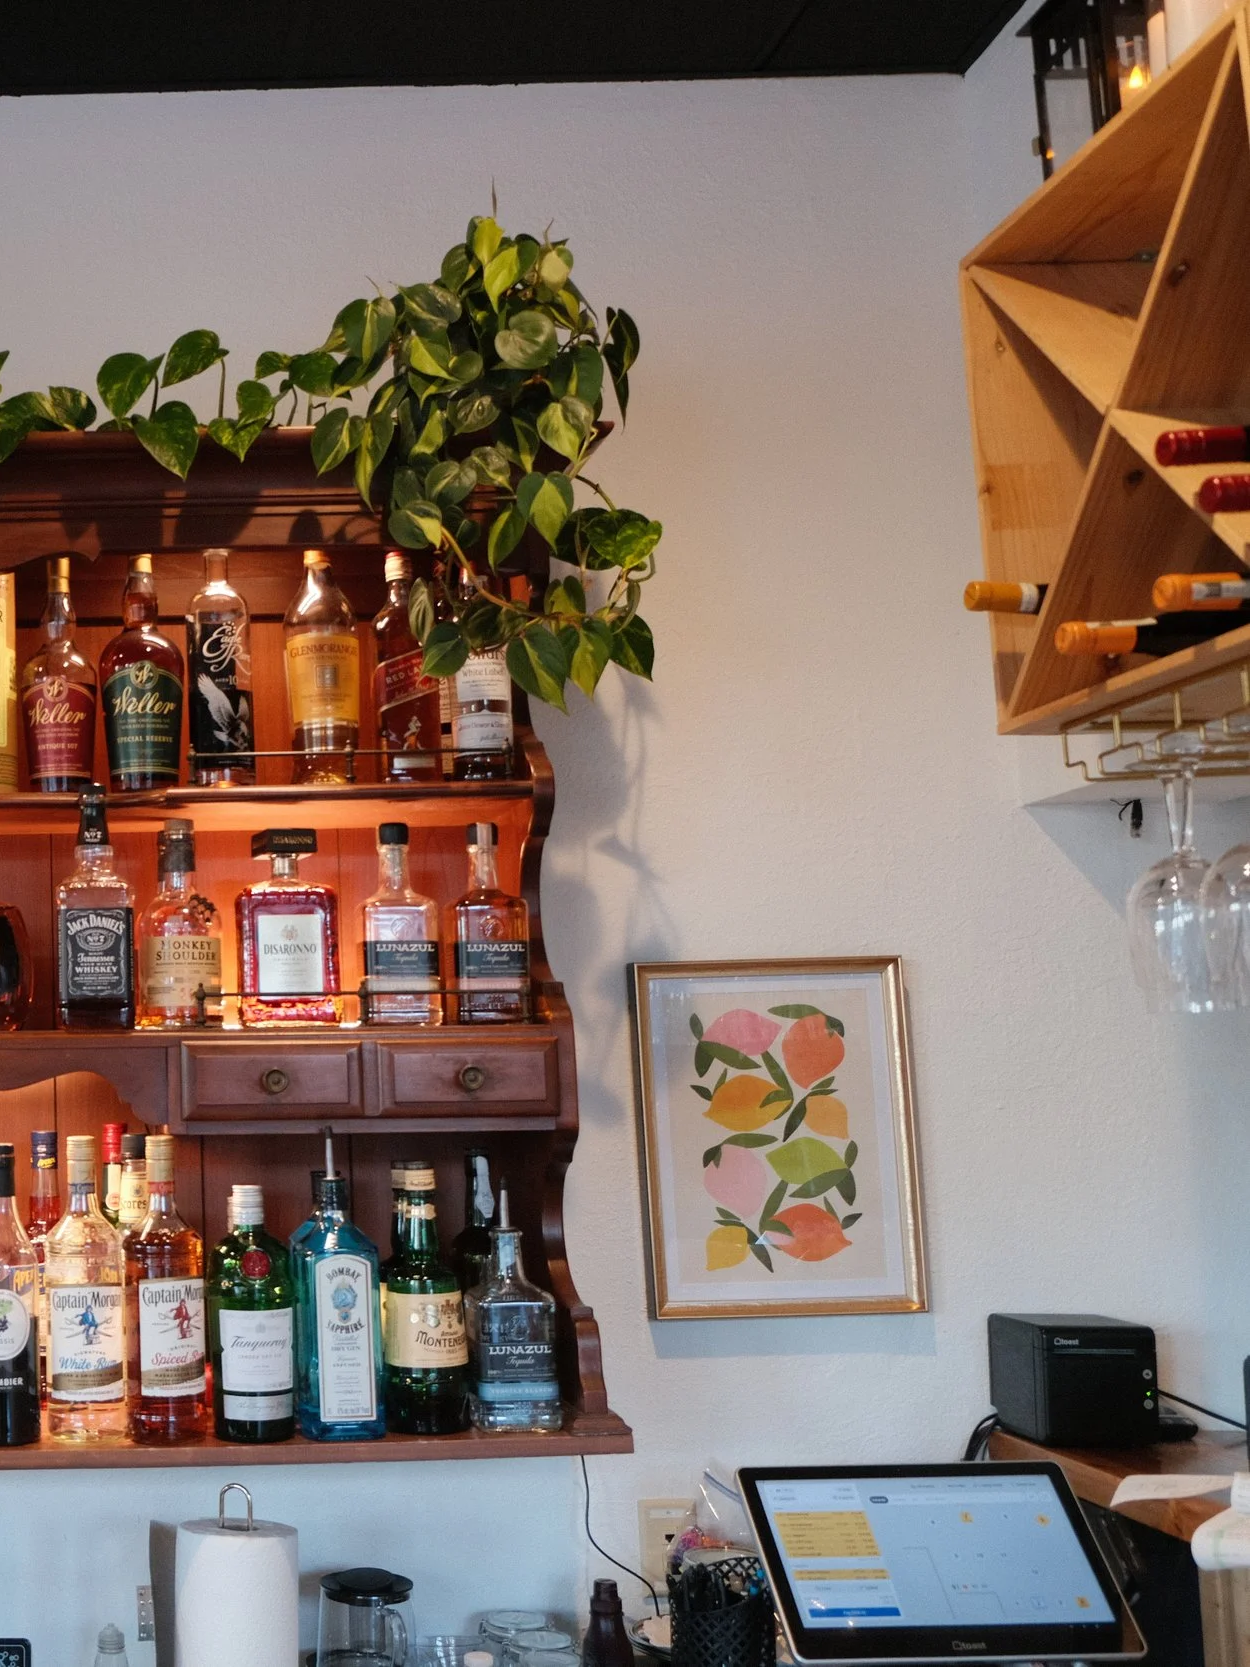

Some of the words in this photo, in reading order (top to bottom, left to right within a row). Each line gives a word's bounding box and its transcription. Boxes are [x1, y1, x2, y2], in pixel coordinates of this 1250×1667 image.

[202, 621, 242, 662] Eagle
[385, 671, 406, 685] RED
[462, 668, 484, 678] White
[229, 675, 239, 686] 10
[112, 686, 178, 716] Weller
[28, 698, 87, 727] Weller
[272, 835, 314, 845] DISARONNO
[66, 917, 90, 936] JACK
[89, 913, 126, 936] DANIEL'S
[160, 940, 212, 950] MONKEY
[263, 943, 317, 956] DISARONNO
[375, 943, 436, 953] LUNAZUL
[466, 943, 526, 953] LUNAZUL
[77, 952, 115, 963] Tennessee
[155, 950, 217, 961] SHOULDER
[393, 952, 419, 964] Tequila
[482, 952, 510, 964] Tequila
[75, 965, 118, 974] WHISKEY
[325, 1267, 361, 1284] BOMBAY
[52, 1291, 88, 1311] Captain
[89, 1291, 121, 1310] Morgan
[142, 1286, 182, 1307] Captain
[326, 1317, 366, 1334] SAPPHIRE
[230, 1335, 288, 1351] Tanqueray
[488, 1344, 553, 1355] LUNAZUL
[59, 1356, 91, 1370] White
[93, 1356, 118, 1369] Rum
[151, 1351, 189, 1366] Spiced
[504, 1355, 535, 1368] Tequila
[962, 1641, 988, 1650] toast
